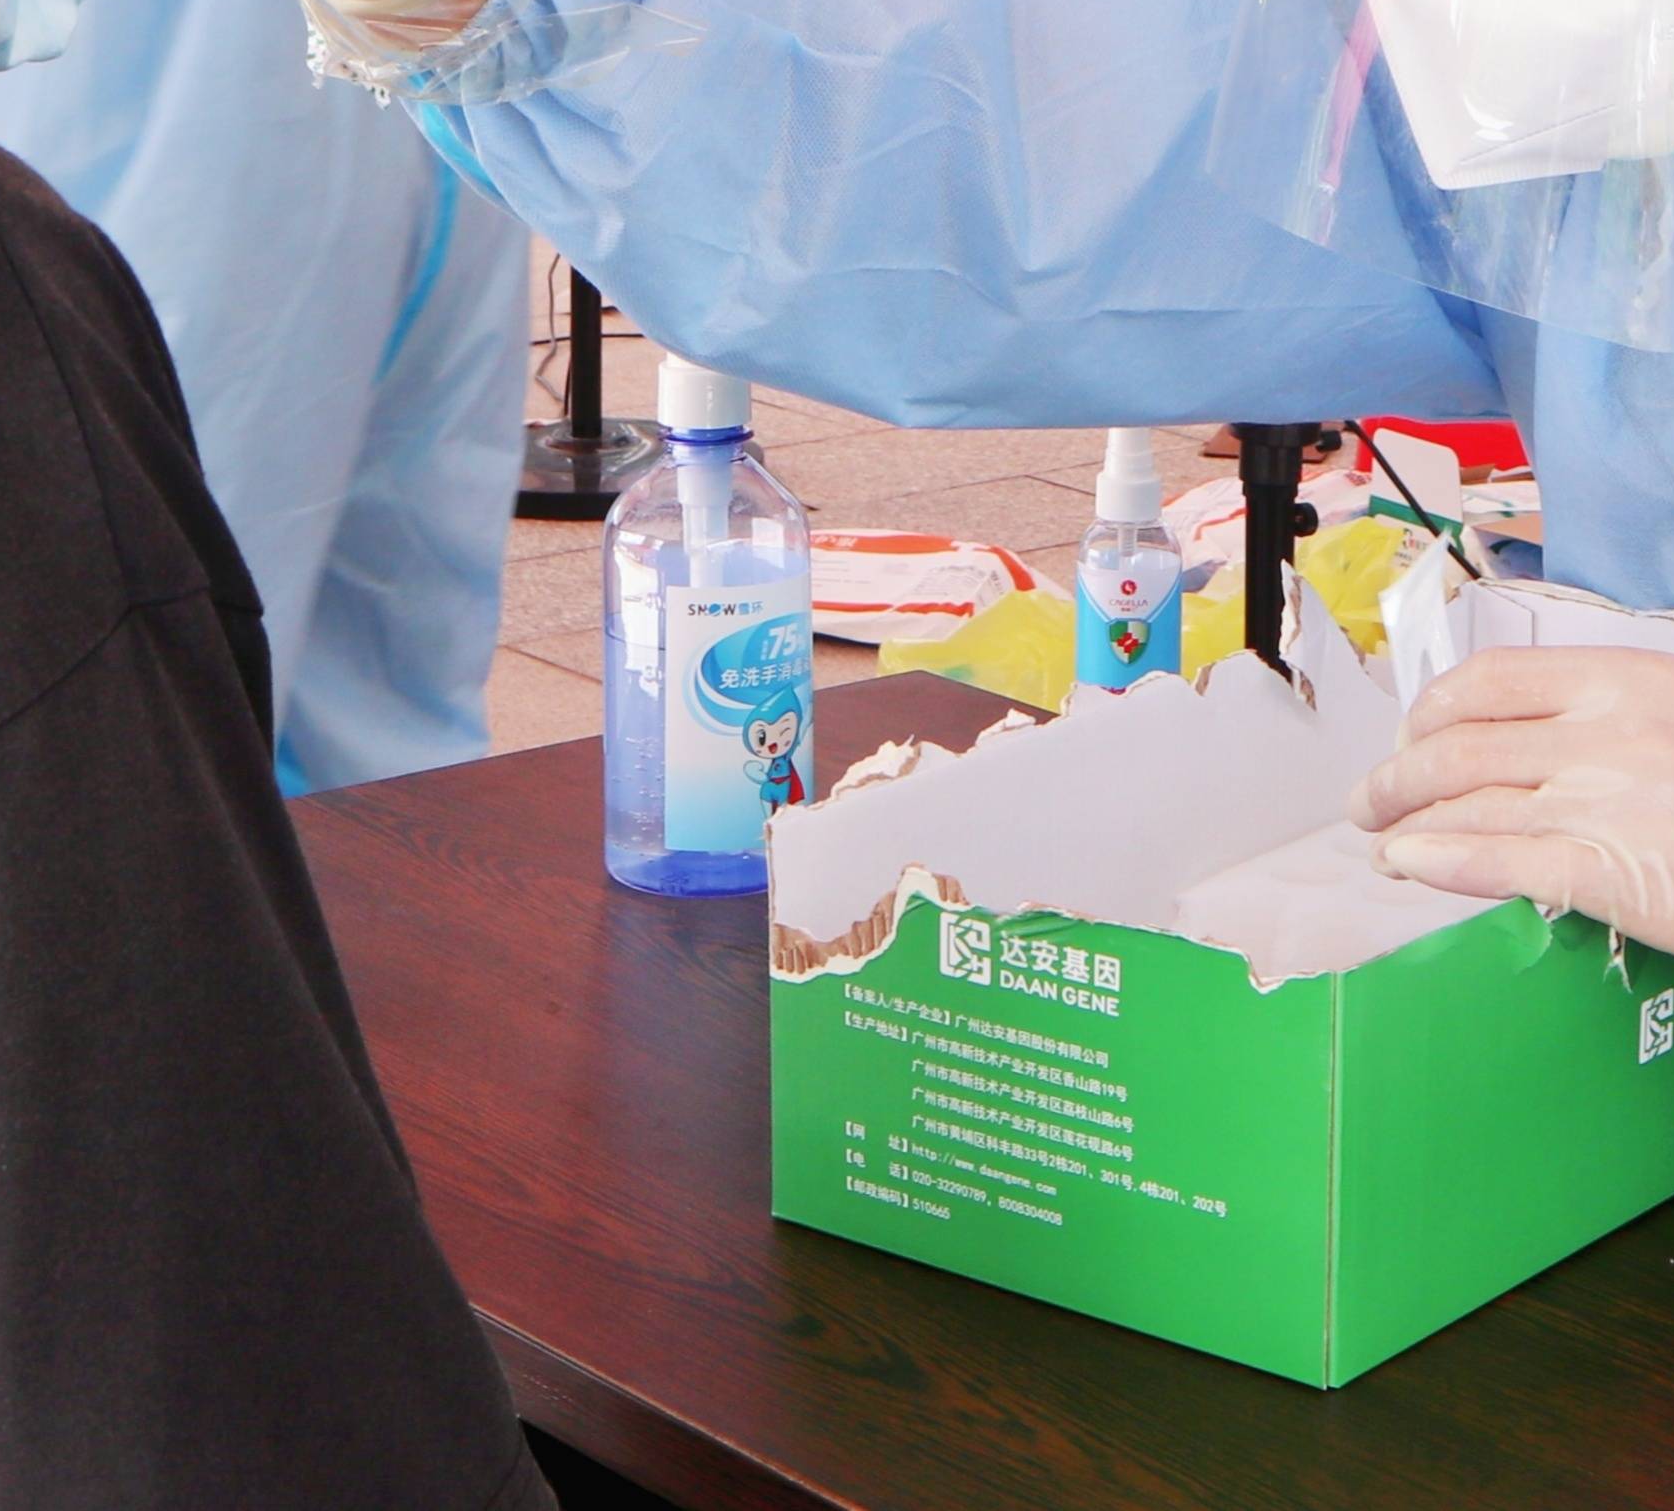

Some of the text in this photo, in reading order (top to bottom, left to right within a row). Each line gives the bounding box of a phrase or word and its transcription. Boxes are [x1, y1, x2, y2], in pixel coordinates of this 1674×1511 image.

[999, 930, 1122, 993] 达安基因
[999, 970, 1120, 1017] DAAN GENE
